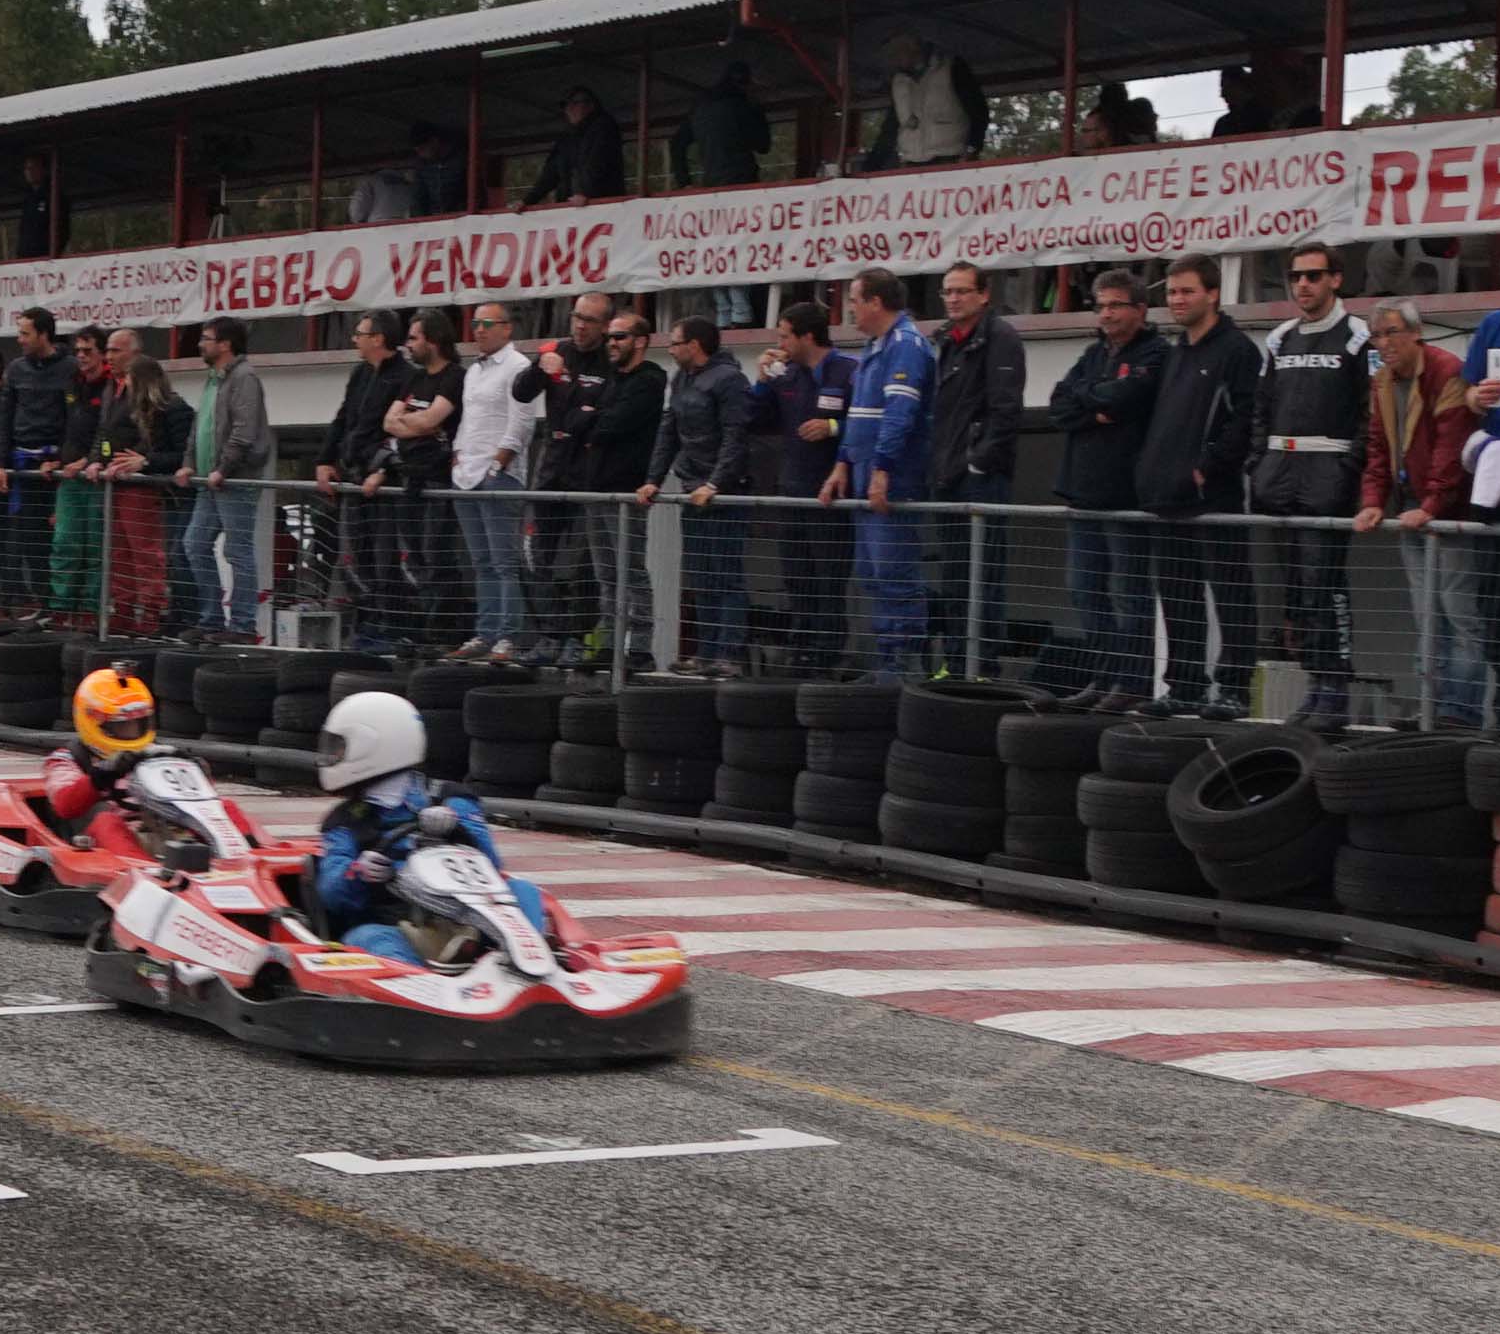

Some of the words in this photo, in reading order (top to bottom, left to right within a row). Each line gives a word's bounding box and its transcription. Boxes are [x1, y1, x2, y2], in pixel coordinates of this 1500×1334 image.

[643, 205, 763, 242] MÁQUINAS
[769, 200, 804, 232] DE
[810, 192, 891, 228] VENDA
[898, 175, 1073, 221] AUTOMÁTICA
[1101, 158, 1179, 204] CAFÉ
[1188, 164, 1209, 198] E
[1218, 150, 1347, 196] SNACKS
[203, 245, 363, 314] REBELO
[388, 223, 614, 298] VENDING
[746, 242, 784, 273] 234
[842, 232, 891, 263] 989
